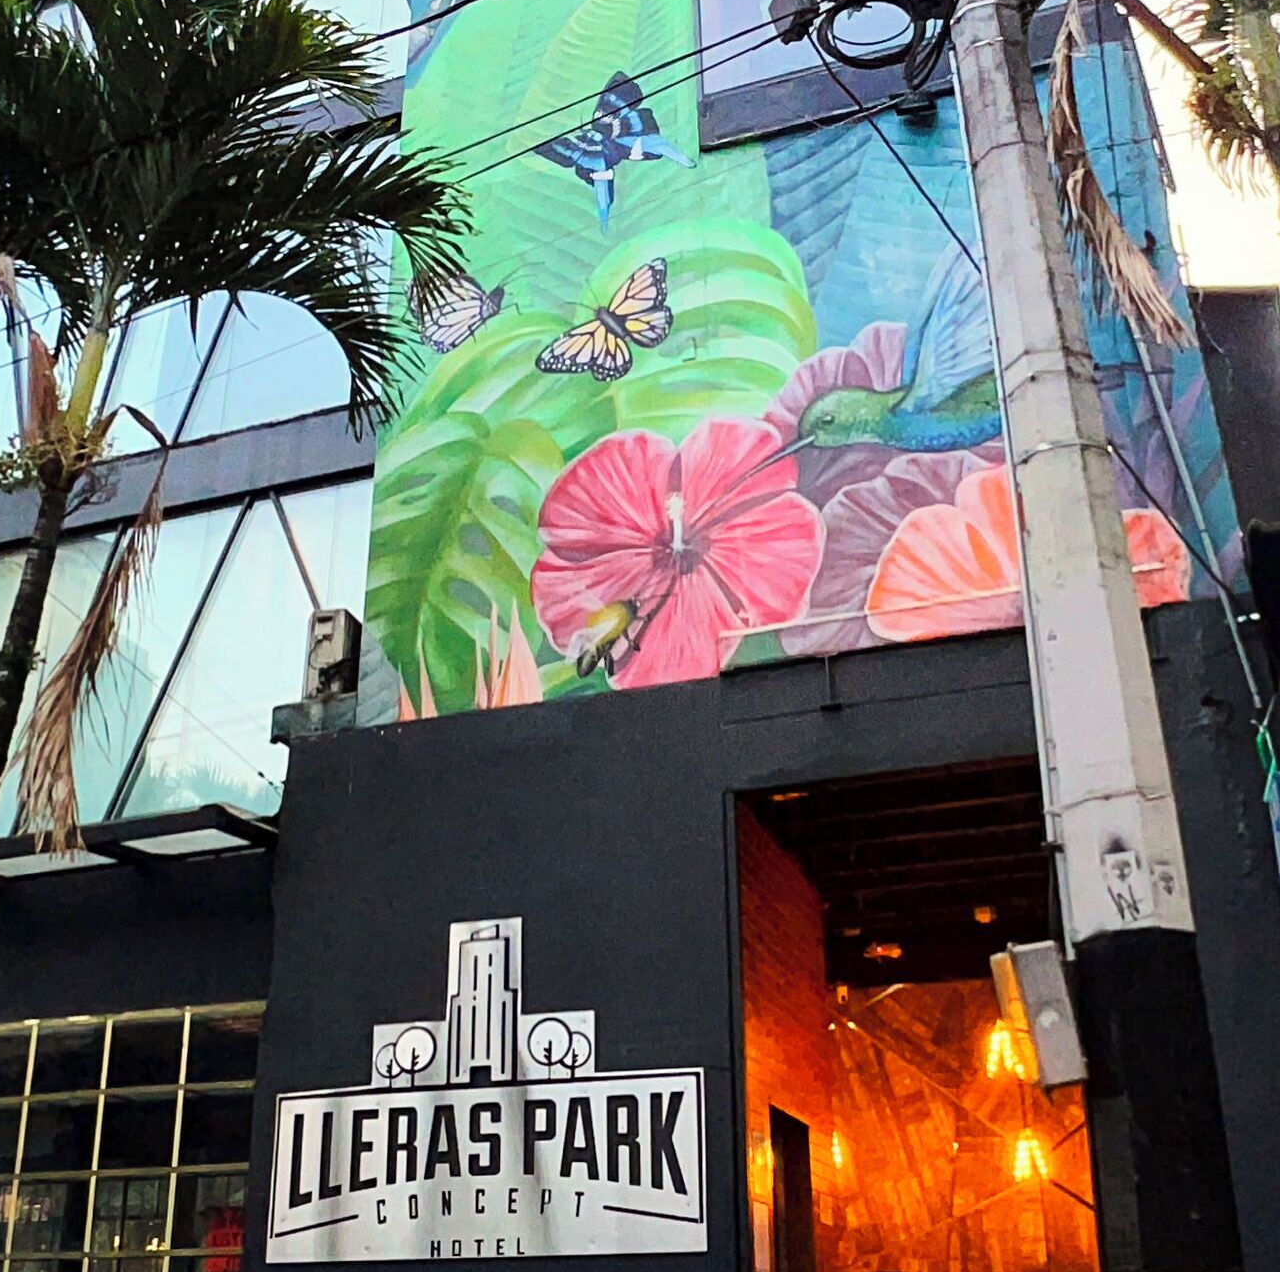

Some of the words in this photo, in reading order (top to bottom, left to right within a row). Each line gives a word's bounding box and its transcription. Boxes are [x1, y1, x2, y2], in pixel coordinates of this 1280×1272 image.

[289, 1103, 502, 1209] LLERAS
[523, 1091, 688, 1196] PARK
[376, 1188, 586, 1225] CONCEPT
[430, 1239, 525, 1258] HOTEL
